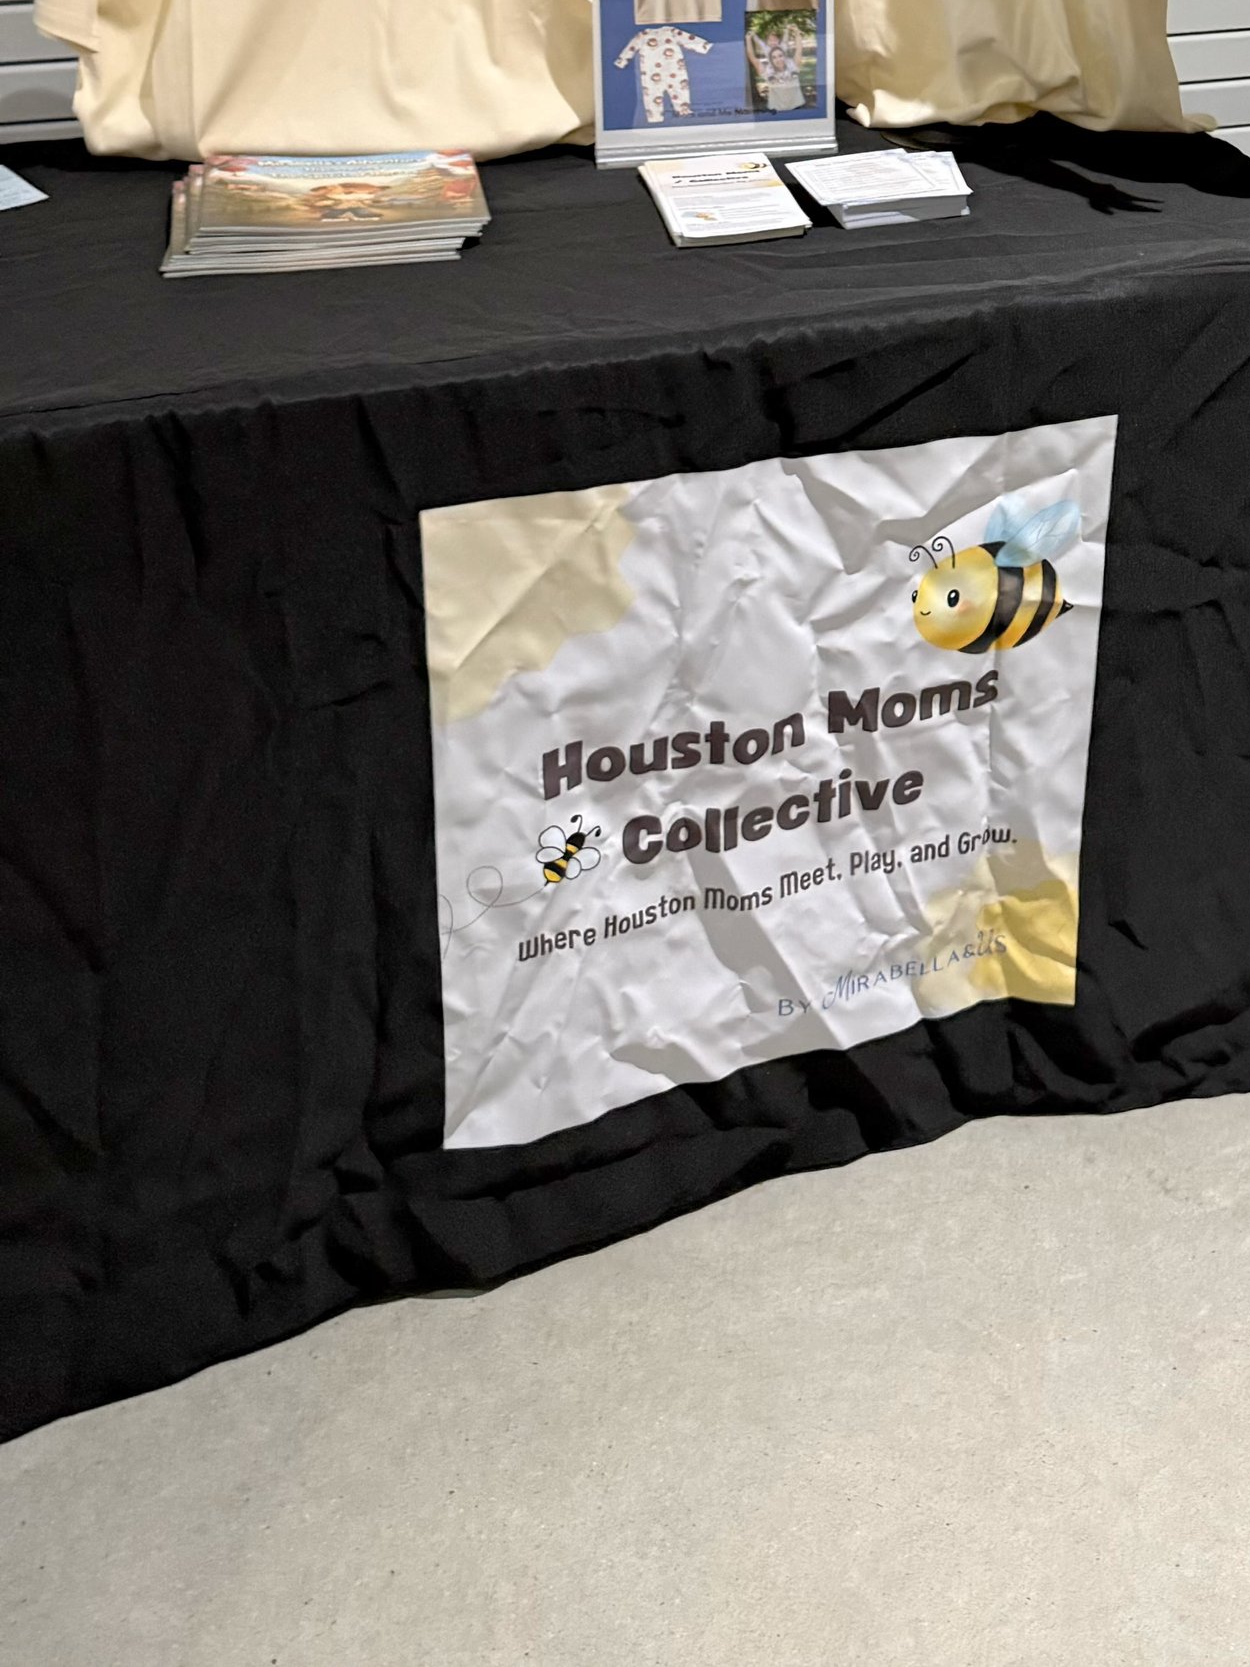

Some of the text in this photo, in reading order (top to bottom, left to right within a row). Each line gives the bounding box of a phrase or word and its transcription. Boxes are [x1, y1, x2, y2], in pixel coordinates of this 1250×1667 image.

[542, 669, 999, 801] Houston Moms
[621, 767, 925, 865] Collective
[518, 927, 597, 962] Where
[603, 894, 696, 939] Houston
[703, 885, 774, 912] Moms
[910, 834, 950, 864] and
[957, 826, 1018, 855] Grow.
